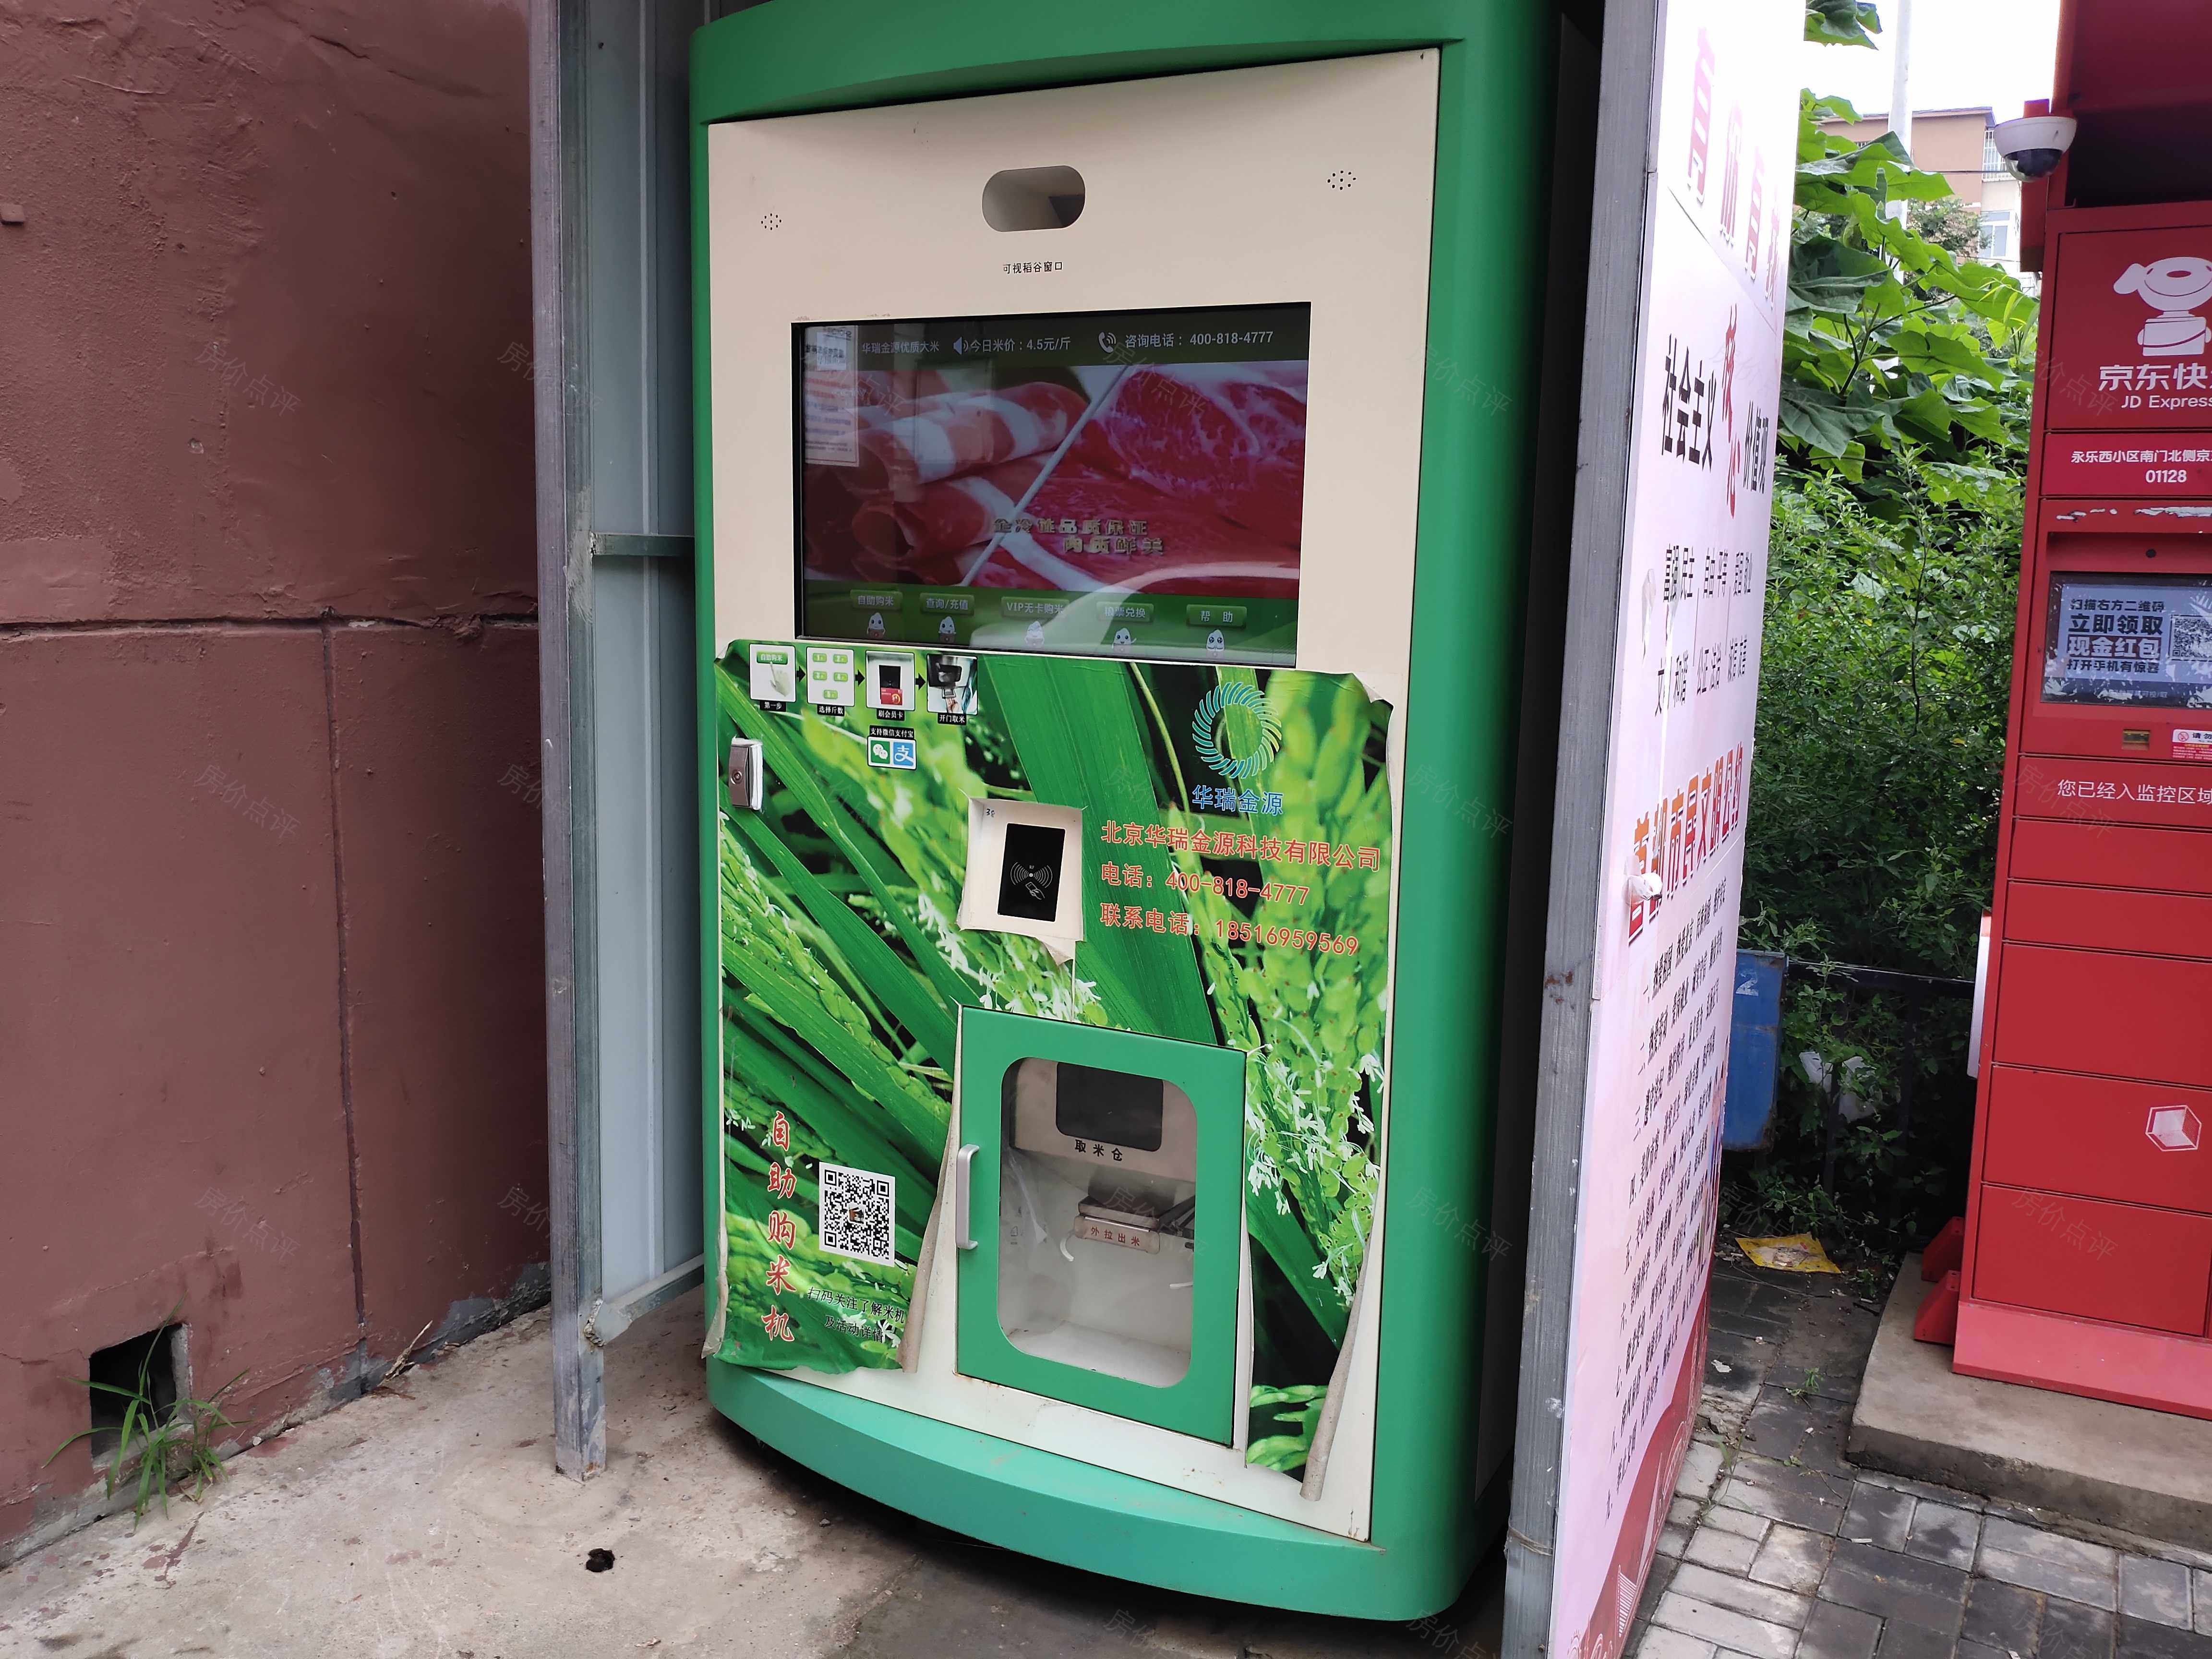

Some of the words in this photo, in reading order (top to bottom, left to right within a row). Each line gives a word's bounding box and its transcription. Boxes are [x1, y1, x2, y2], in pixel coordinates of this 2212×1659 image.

[1003, 261, 1062, 274] 可视稻谷窗口
[862, 340, 939, 354] 华瑞金源优质大米
[2098, 362, 2212, 391] 京东快
[2121, 396, 2141, 408] JD
[2071, 449, 2212, 463] 永乐西小区南门北侧京
[2145, 470, 2187, 483] 01128
[857, 595, 894, 606] 自助购米
[926, 598, 969, 611] 查询/充值
[1007, 602, 1063, 614] VIP无卡购米
[2070, 598, 2164, 612] 扫描右方二维码
[2068, 614, 2163, 635] 立即领取
[2068, 636, 2160, 659] 现金红包
[2067, 659, 2160, 674] 打开手机有惊喜
[764, 701, 782, 710] 第一步
[818, 706, 844, 715] 选择斤数
[878, 711, 903, 719] 刷会员卡
[939, 715, 965, 723] 开门取米
[870, 727, 914, 738] 支持微信支付宝
[1191, 784, 1284, 816] 华瑞金源
[1101, 819, 1381, 872] 北京华瑞金源科技有限公司
[1736, 969, 1758, 996] 2
[1074, 1139, 1123, 1162] 取米仓
[761, 1110, 797, 1342] 自助购米机
[1090, 1226, 1141, 1247] 外拉出米
[806, 1286, 905, 1324] 扫码关注了解米机
[824, 1315, 884, 1344] 及活动详情
